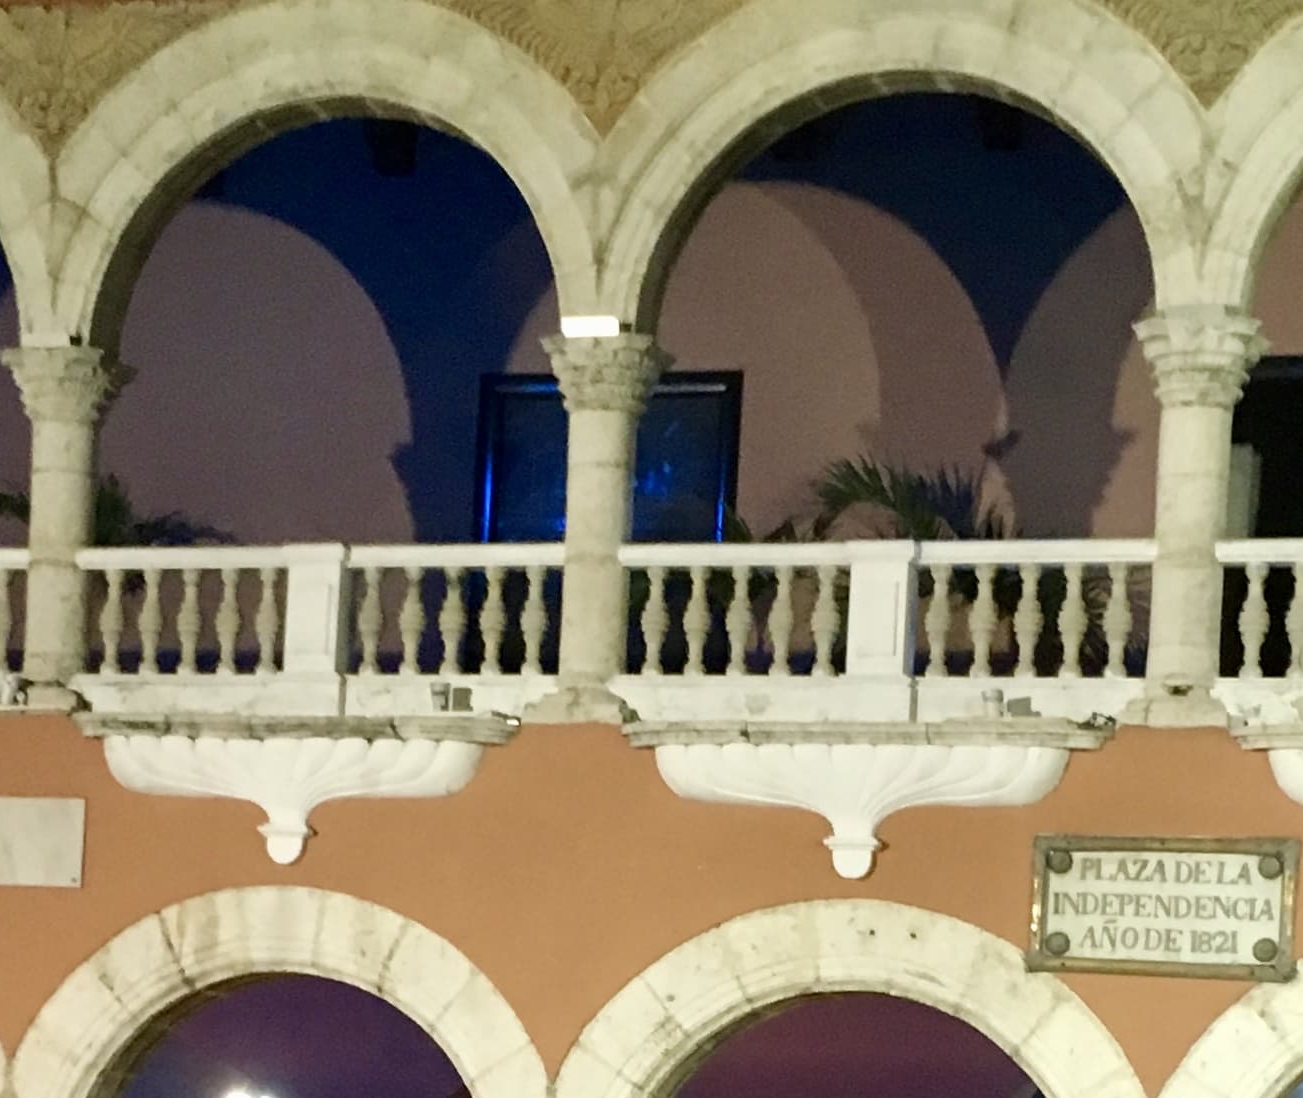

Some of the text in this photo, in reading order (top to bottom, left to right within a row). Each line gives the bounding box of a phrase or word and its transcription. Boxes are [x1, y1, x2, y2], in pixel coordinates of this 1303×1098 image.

[1079, 857, 1252, 885] PLAZA DE LA
[1052, 891, 1275, 922] INDEPENDENCIA
[1078, 919, 1239, 955] AÑO DE 1821
